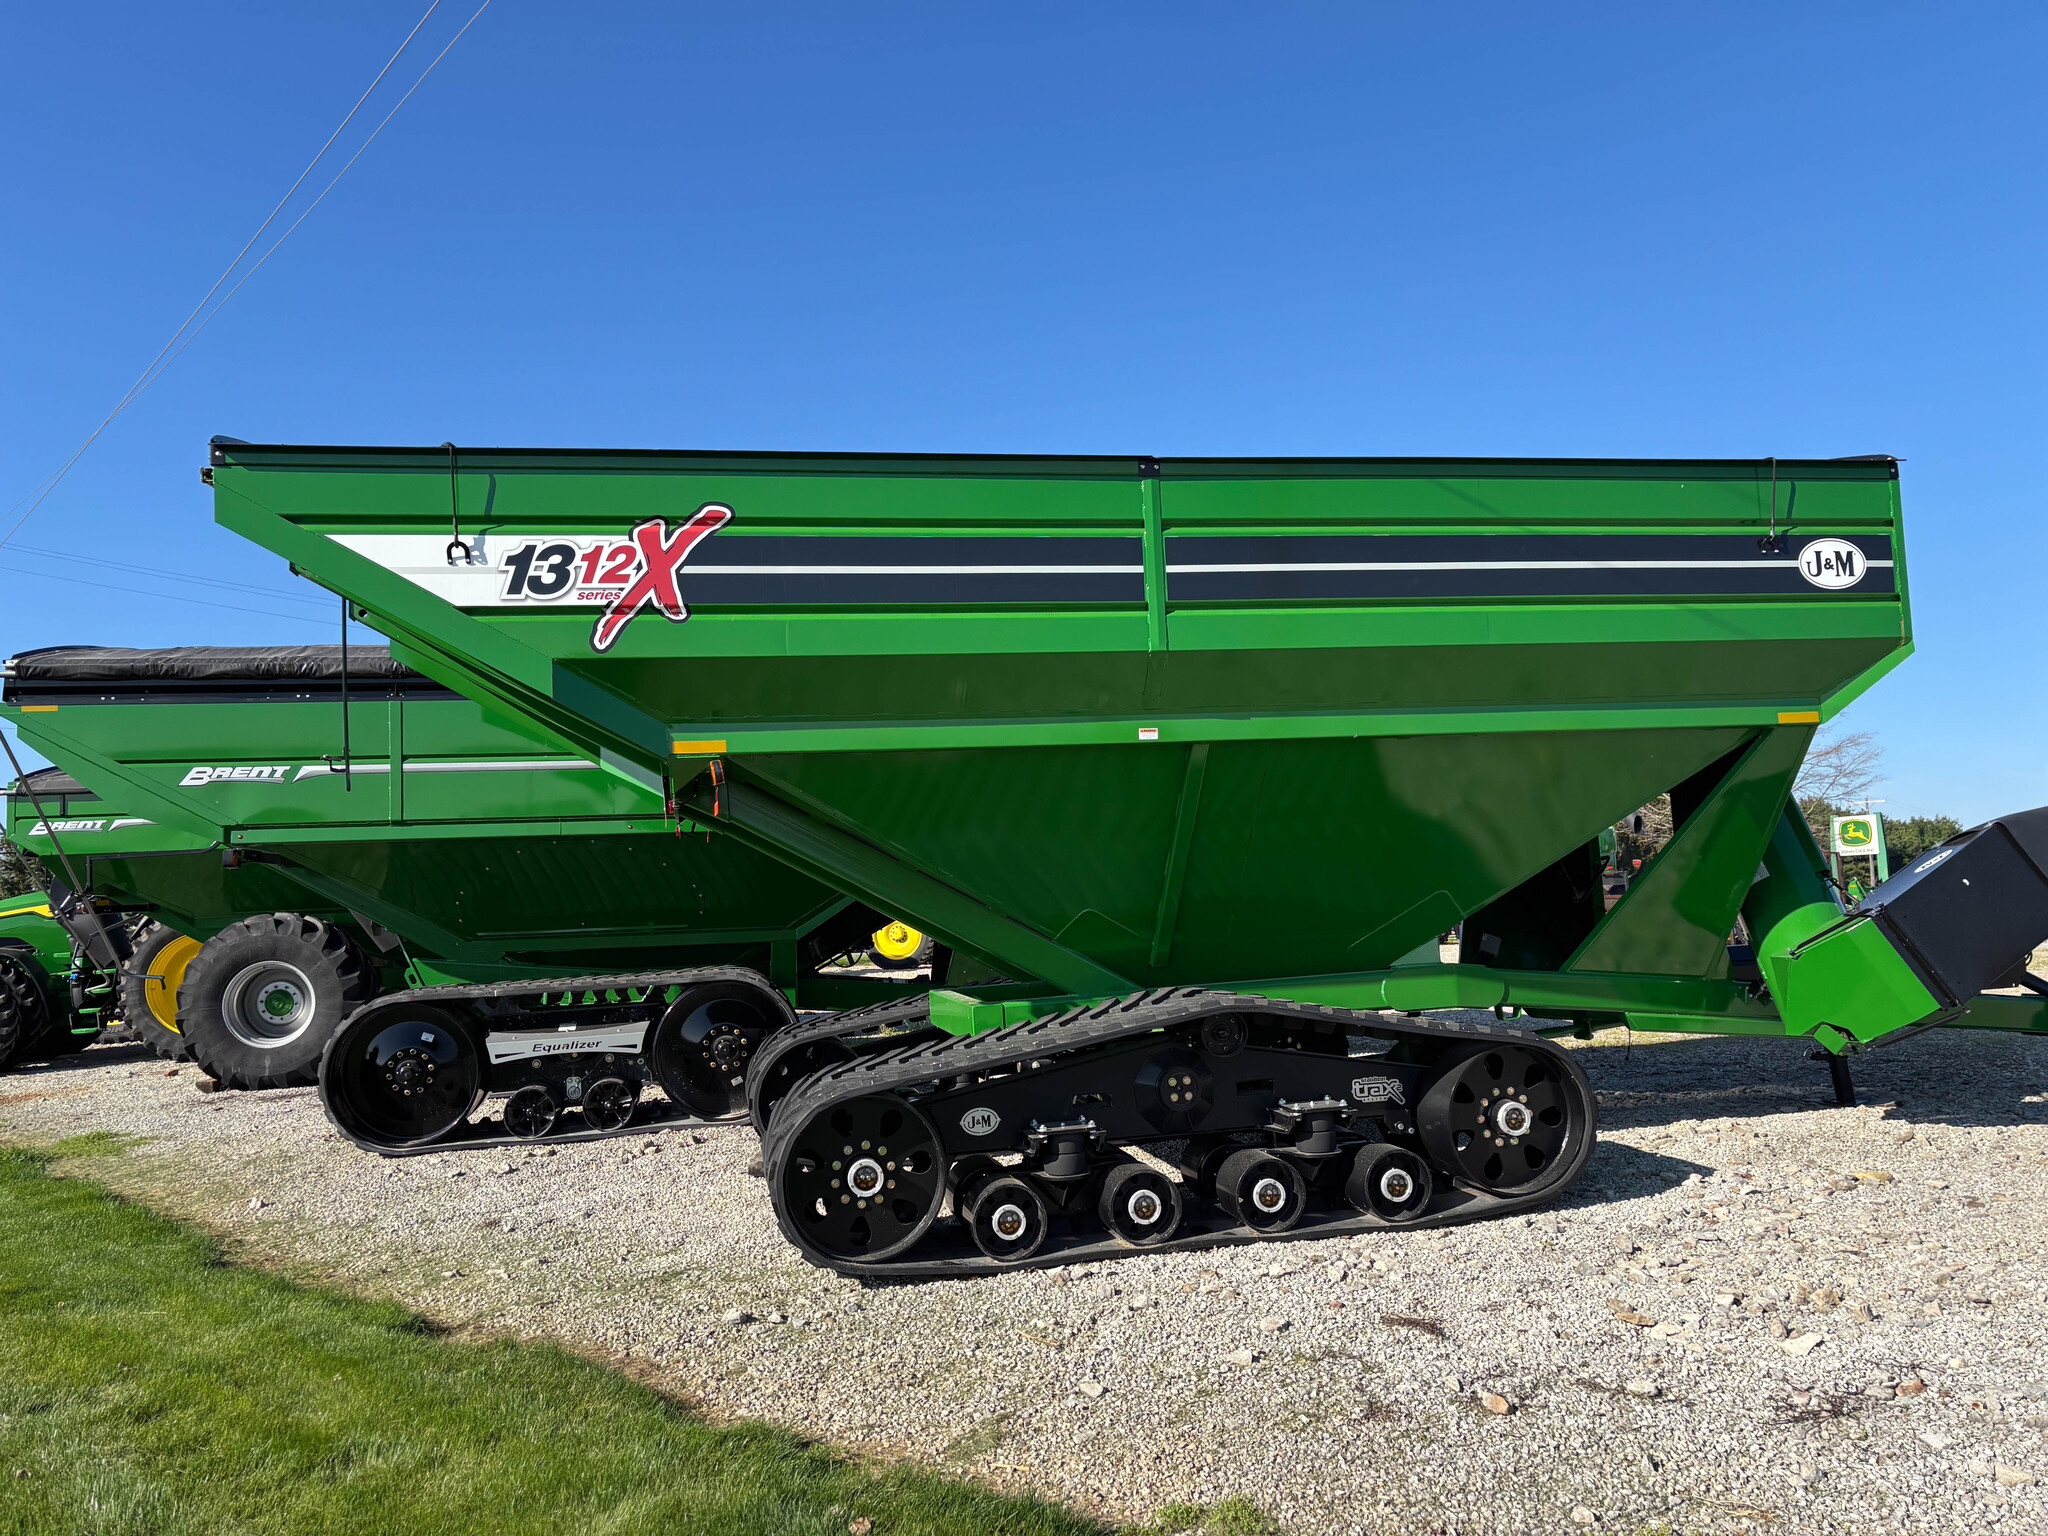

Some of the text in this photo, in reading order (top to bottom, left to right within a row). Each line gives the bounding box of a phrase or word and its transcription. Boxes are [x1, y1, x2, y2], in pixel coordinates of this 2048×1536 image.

[577, 589, 621, 601] series
[178, 766, 291, 786] BRENT
[28, 820, 107, 836] BRENT
[532, 1040, 602, 1054] Equalizer
[967, 1115, 992, 1129] J&M
